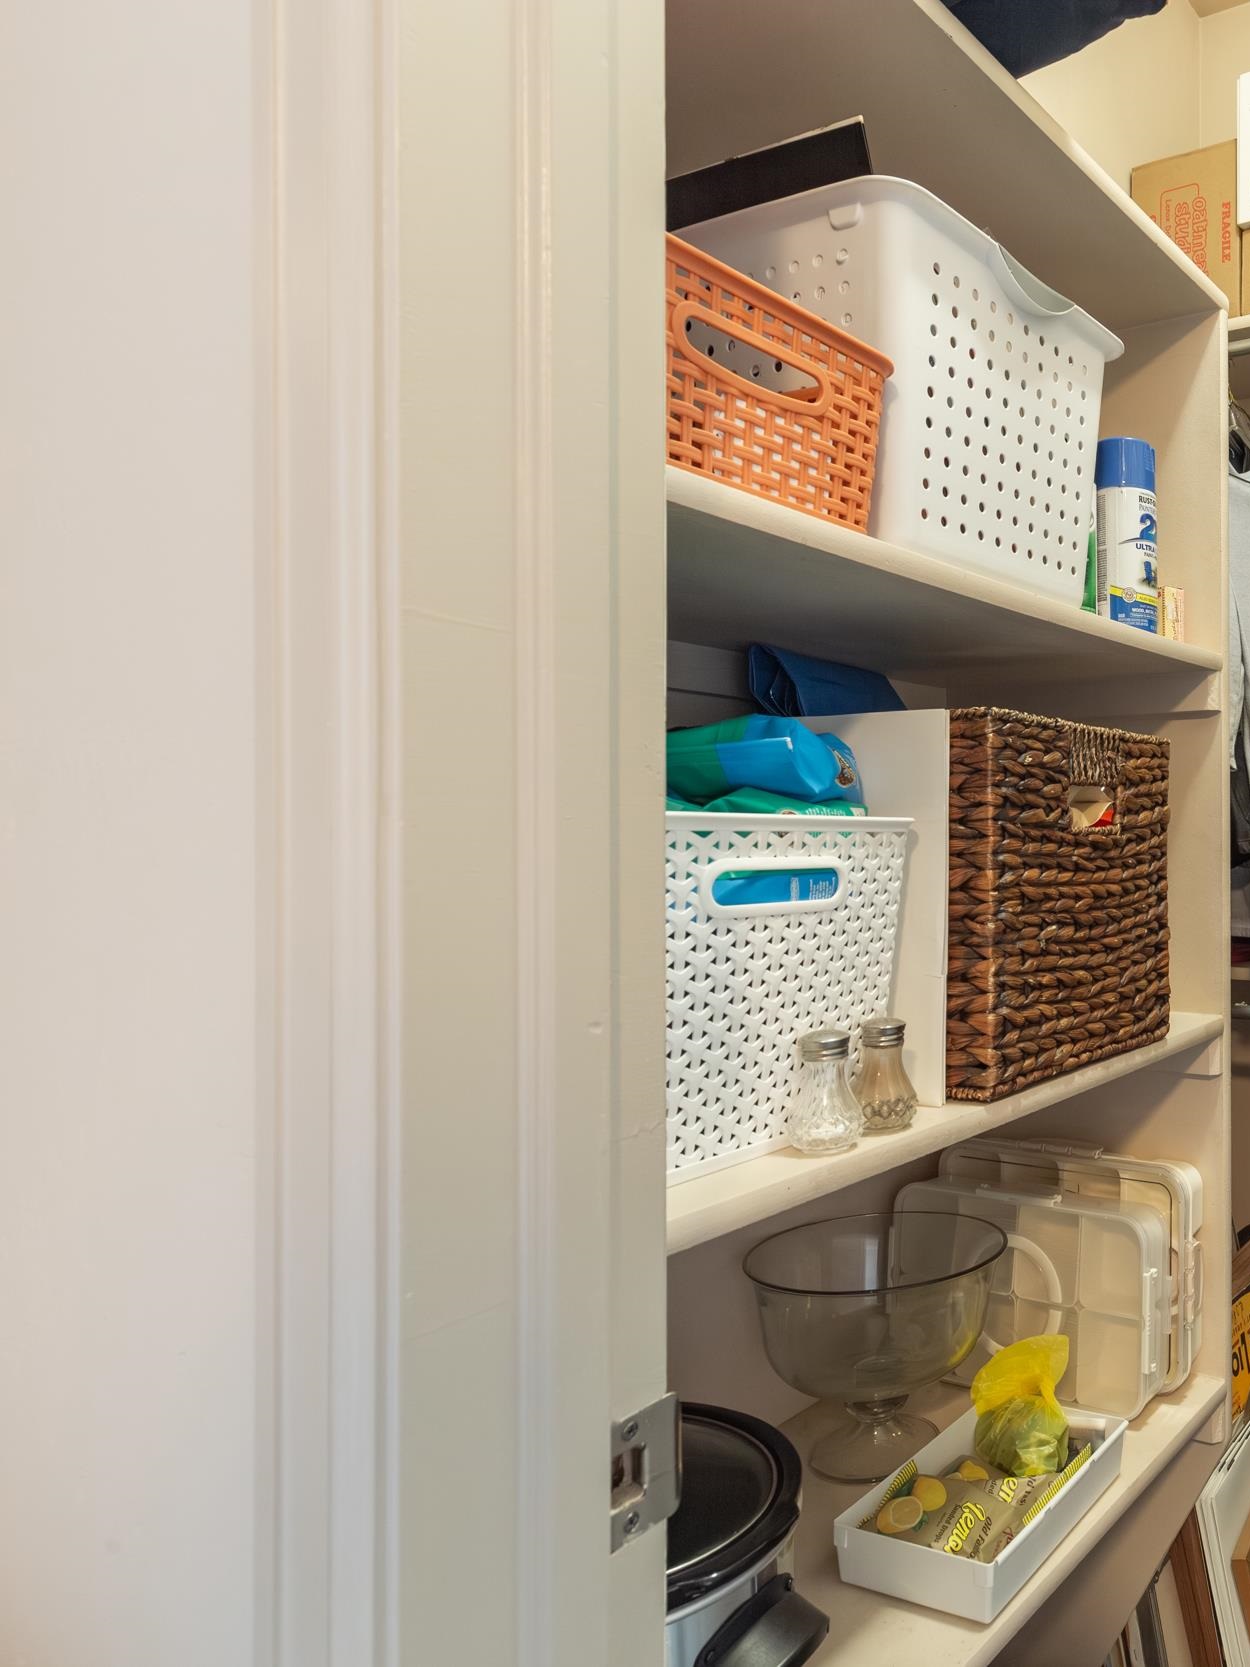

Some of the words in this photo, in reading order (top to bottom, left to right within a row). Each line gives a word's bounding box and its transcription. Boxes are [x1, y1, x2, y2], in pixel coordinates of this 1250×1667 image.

[1191, 196, 1208, 274] oatmea
[1221, 200, 1231, 263] FRAGILE
[1140, 513, 1156, 541] 2
[1136, 543, 1155, 552] ULTRA
[1231, 1330, 1250, 1377] LIO
[981, 1516, 992, 1536] Old
